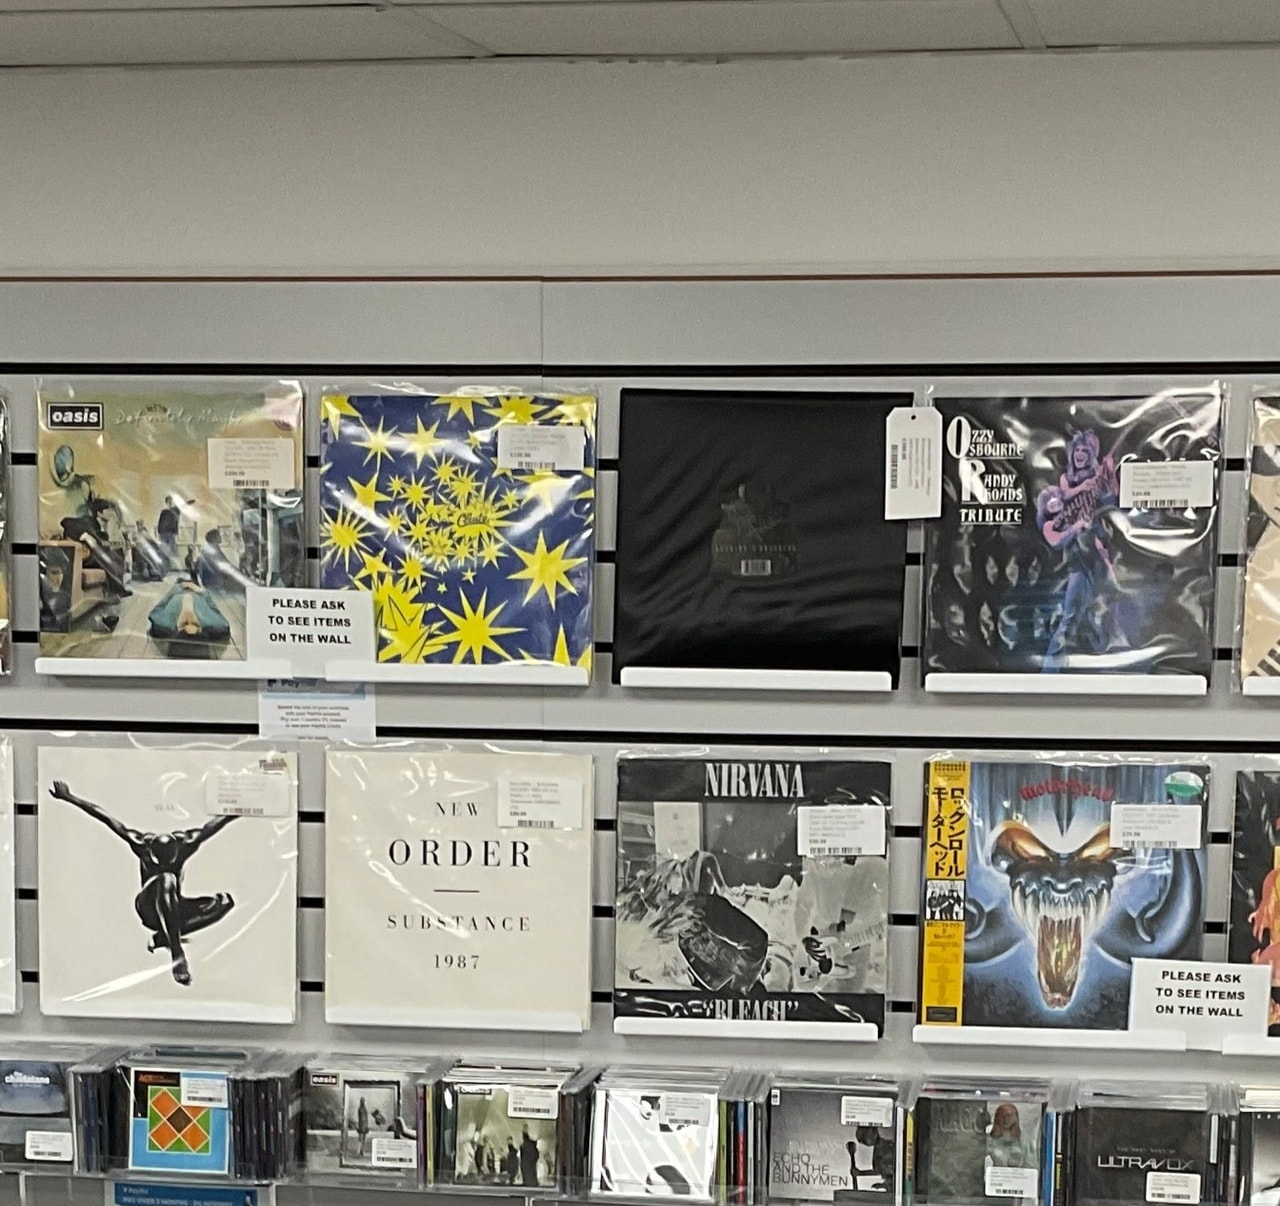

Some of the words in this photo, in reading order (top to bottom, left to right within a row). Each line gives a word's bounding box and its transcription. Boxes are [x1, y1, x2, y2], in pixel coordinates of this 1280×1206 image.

[52, 409, 99, 423] oasis
[959, 508, 1023, 523] TRIBUTE
[272, 599, 317, 609] PLEASE
[321, 601, 345, 610] ASK
[268, 616, 284, 625] TO
[287, 617, 310, 626] SEE
[314, 617, 351, 627] ITEMS
[269, 633, 286, 642] ON
[290, 633, 314, 643] THE
[318, 634, 352, 644] WALL
[704, 763, 805, 798] NIRVANA
[435, 802, 478, 817] NEW
[388, 839, 531, 868] ORDER
[387, 915, 531, 932] SUBSTANCE
[434, 955, 480, 970] 1987
[1162, 970, 1210, 983] PLEASE
[1215, 973, 1242, 983] ASK
[1155, 987, 1173, 997] TO
[1177, 988, 1201, 999] SEE
[1206, 990, 1245, 1001] ITEMS
[1155, 1004, 1174, 1014] ON
[1177, 1005, 1203, 1015] THE
[1209, 1006, 1243, 1017] WALL
[773, 1152, 811, 1164] ECHO
[1097, 1155, 1194, 1169] ULTRAVOX
[773, 1164, 802, 1175] AND
[806, 1165, 830, 1175] THE
[773, 1174, 848, 1187] BUNNYMEN
